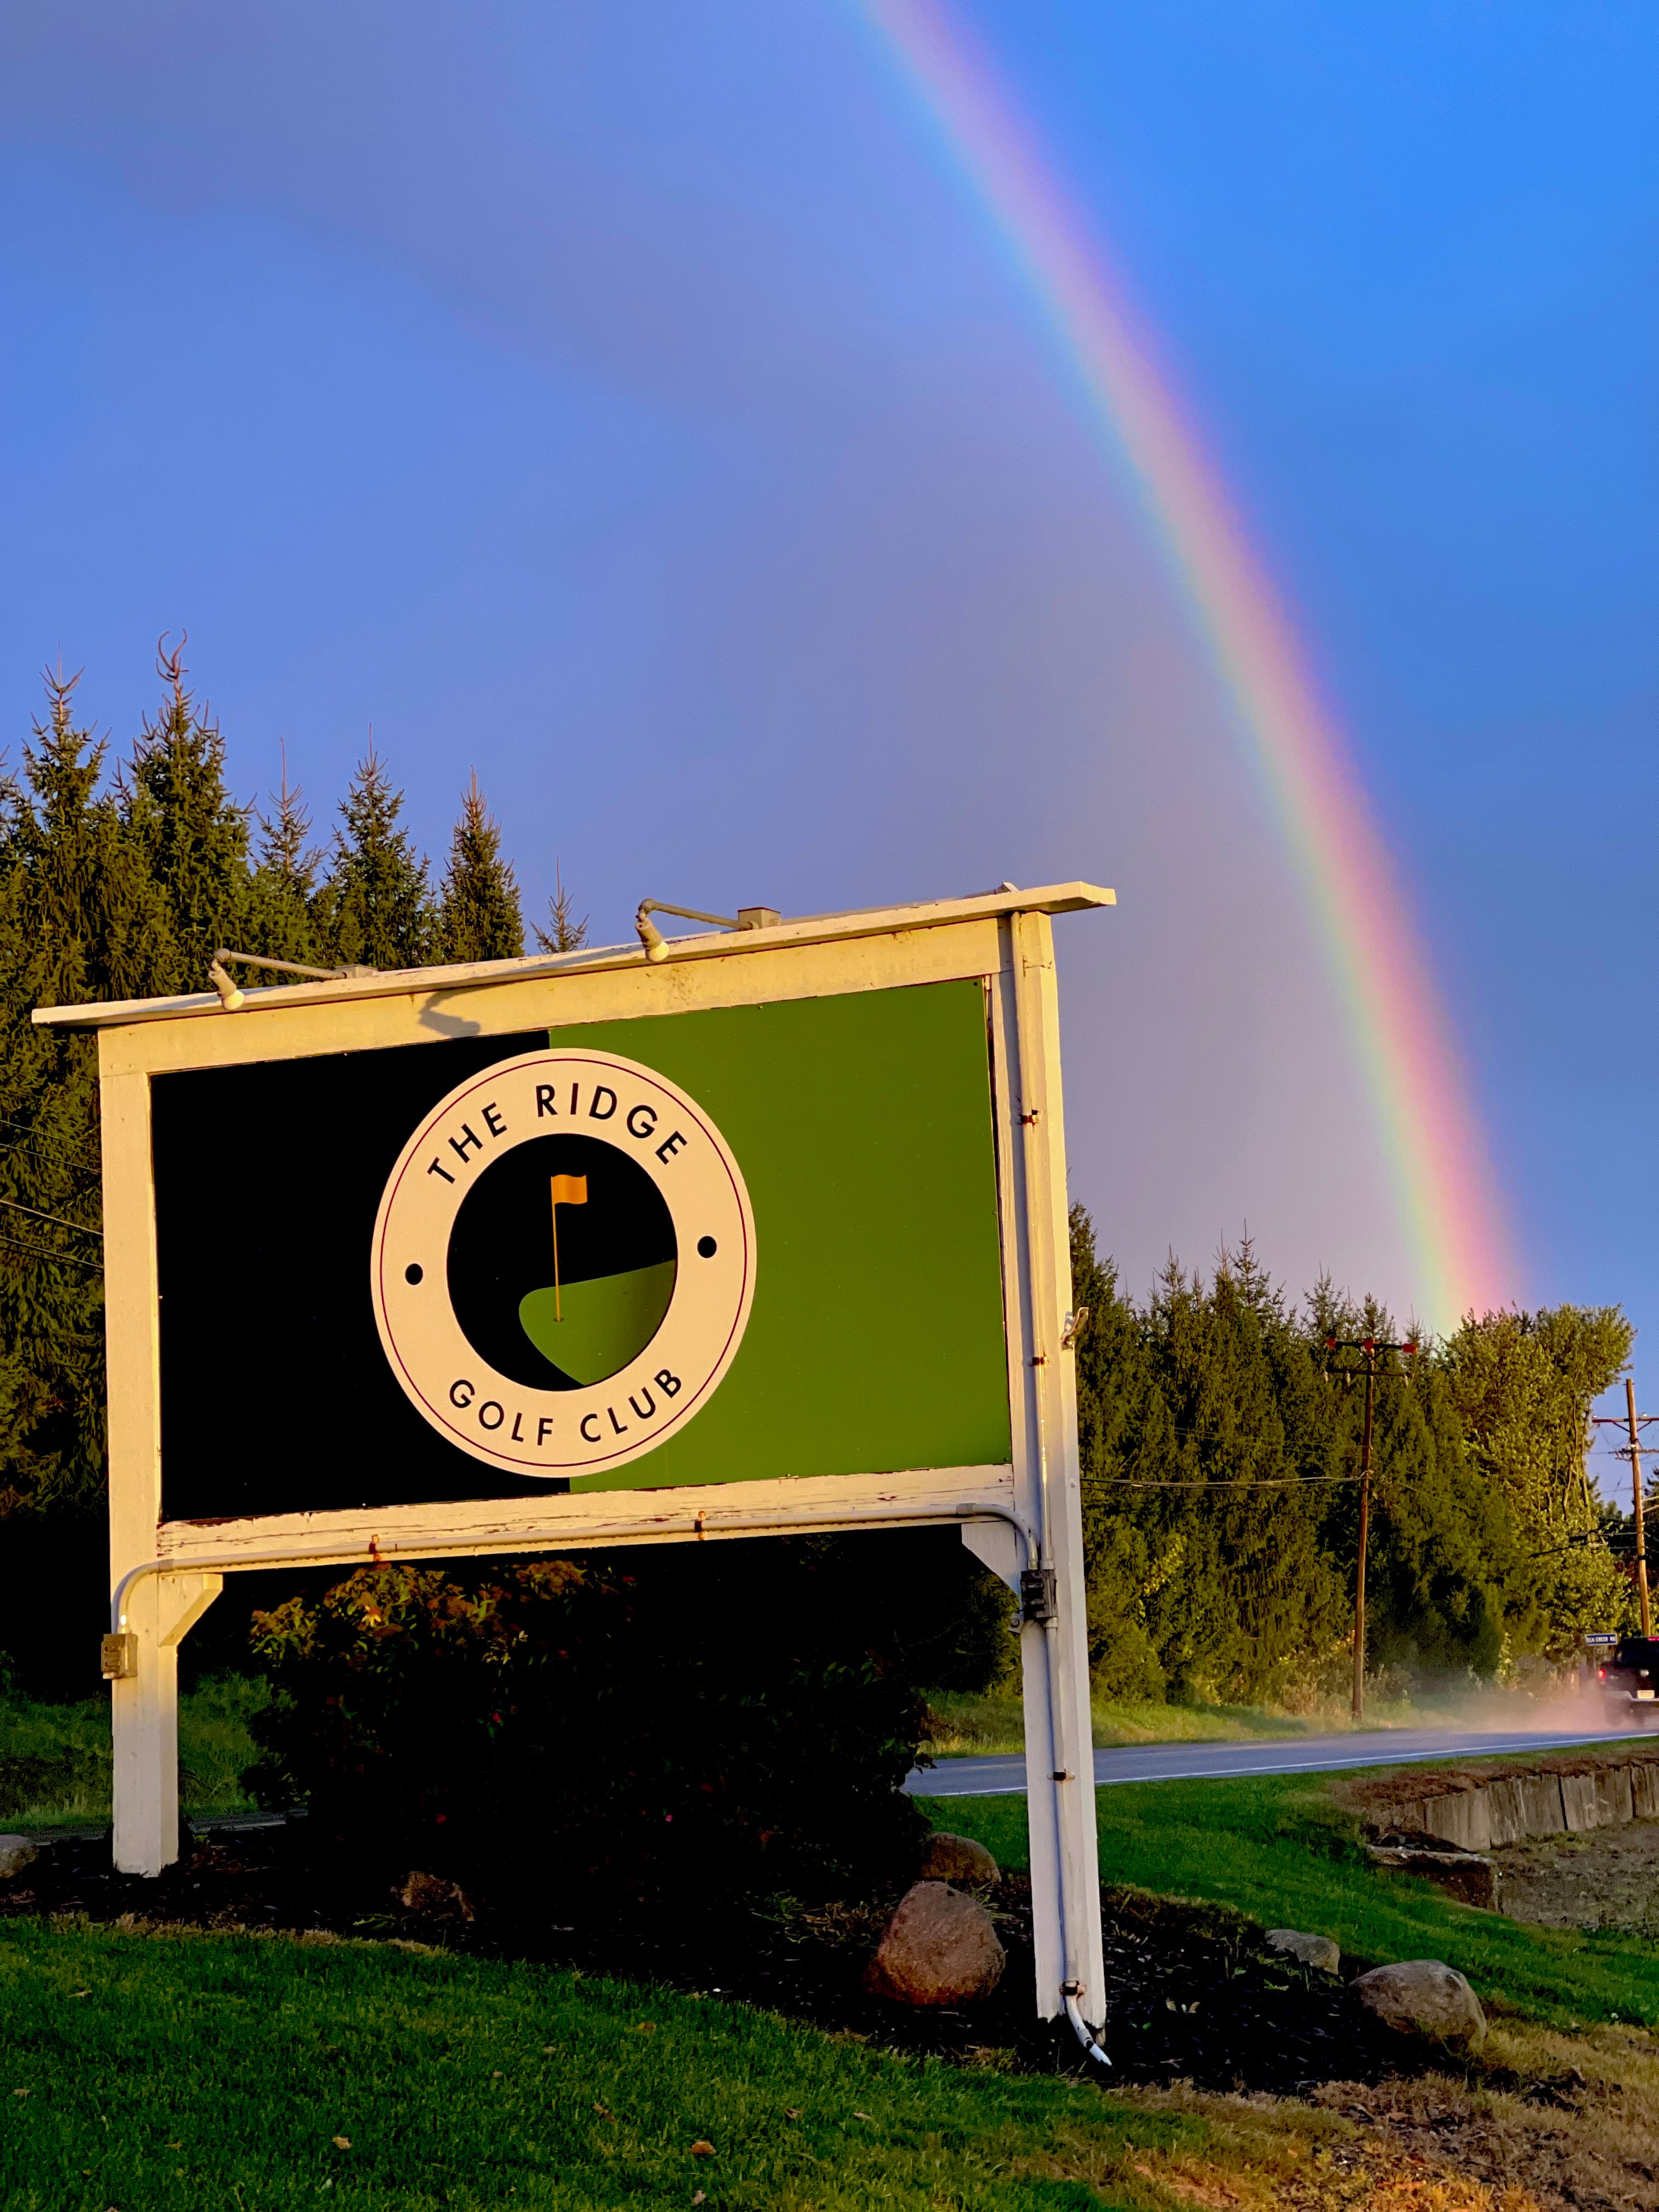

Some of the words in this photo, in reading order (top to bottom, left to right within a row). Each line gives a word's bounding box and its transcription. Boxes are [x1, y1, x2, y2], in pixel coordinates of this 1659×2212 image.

[427, 1102, 508, 1184] THE
[535, 1082, 688, 1165] RIDGE
[449, 1379, 554, 1446] GOLF
[580, 1368, 682, 1443] CLUB
